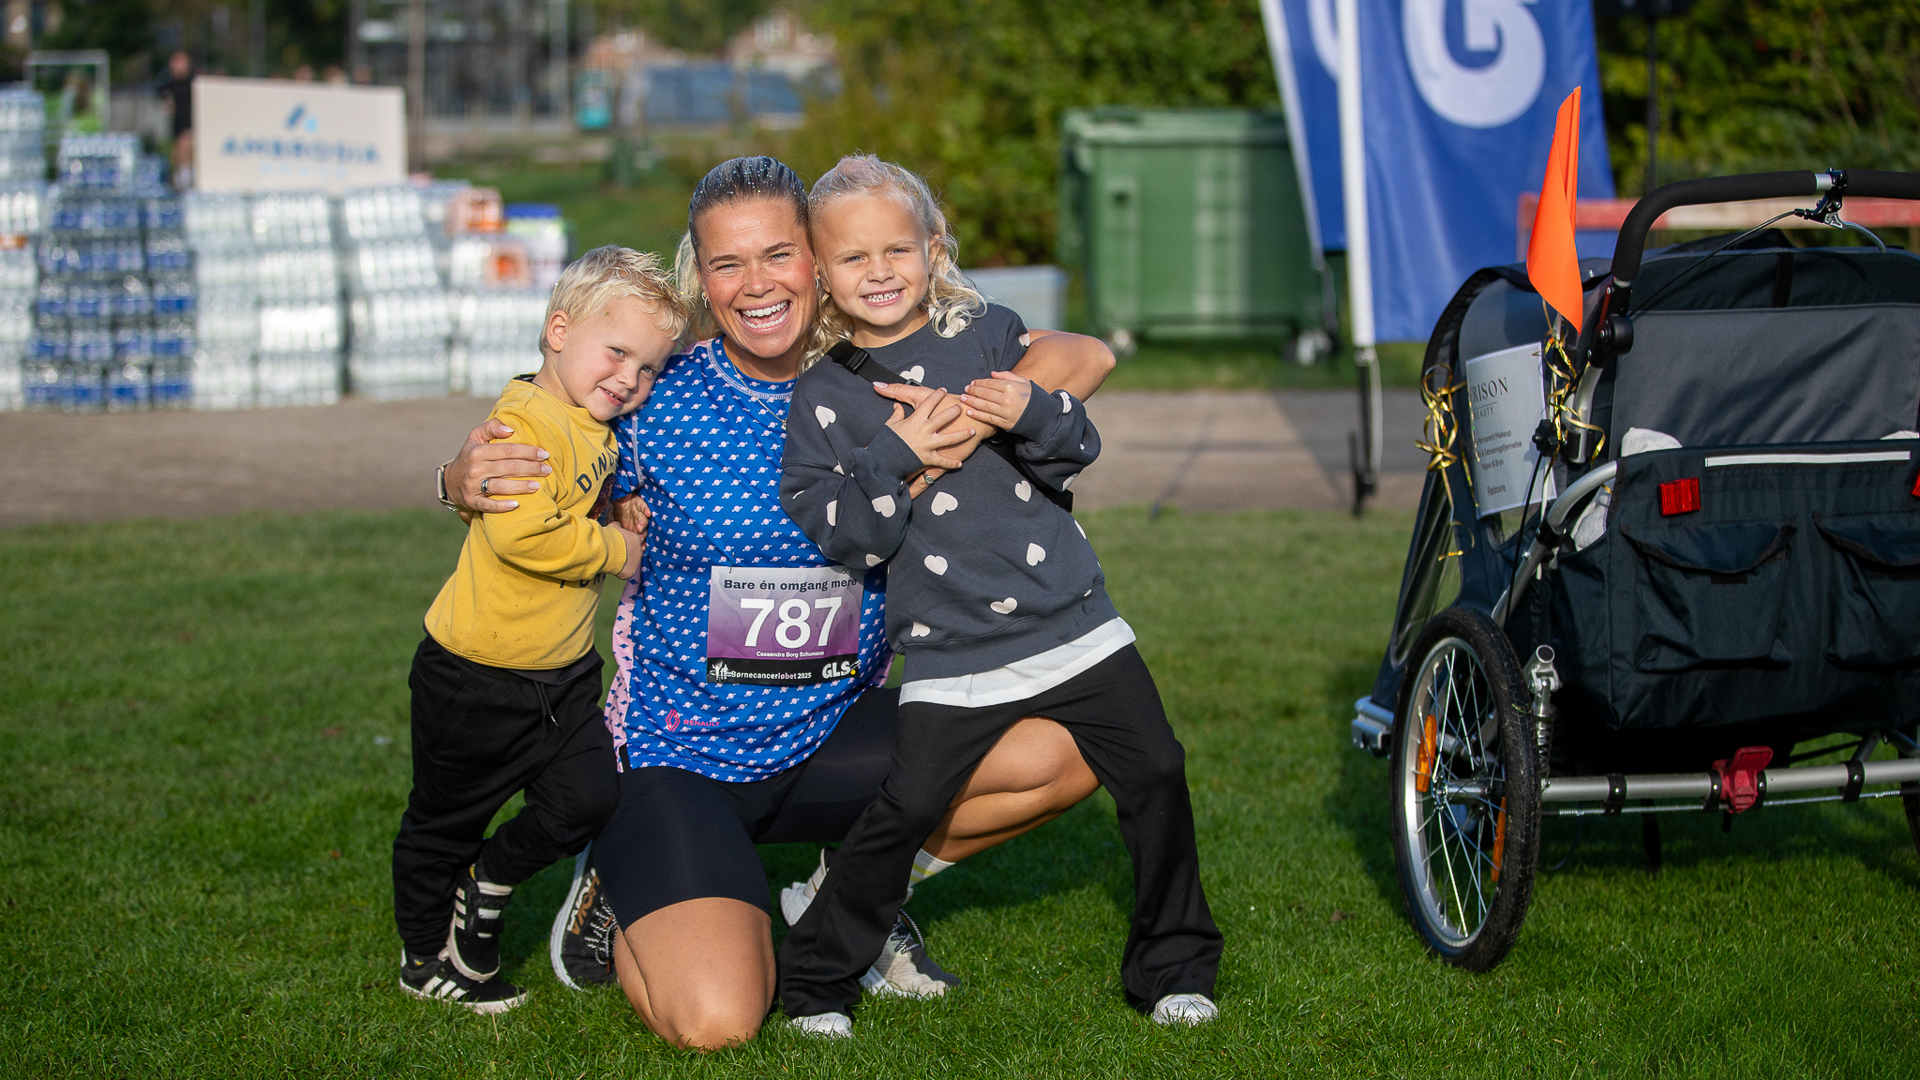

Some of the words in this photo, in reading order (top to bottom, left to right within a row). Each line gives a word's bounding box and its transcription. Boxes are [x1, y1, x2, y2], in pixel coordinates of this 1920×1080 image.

[723, 579, 755, 590] Bare
[759, 580, 775, 590] én
[780, 579, 828, 592] omgang
[831, 578, 857, 589] mere
[740, 596, 842, 649] 787
[731, 671, 797, 680] Børnecancerløbet
[797, 672, 812, 680] 2025
[683, 719, 720, 727] RENAULT
[567, 867, 600, 935] HOKA
